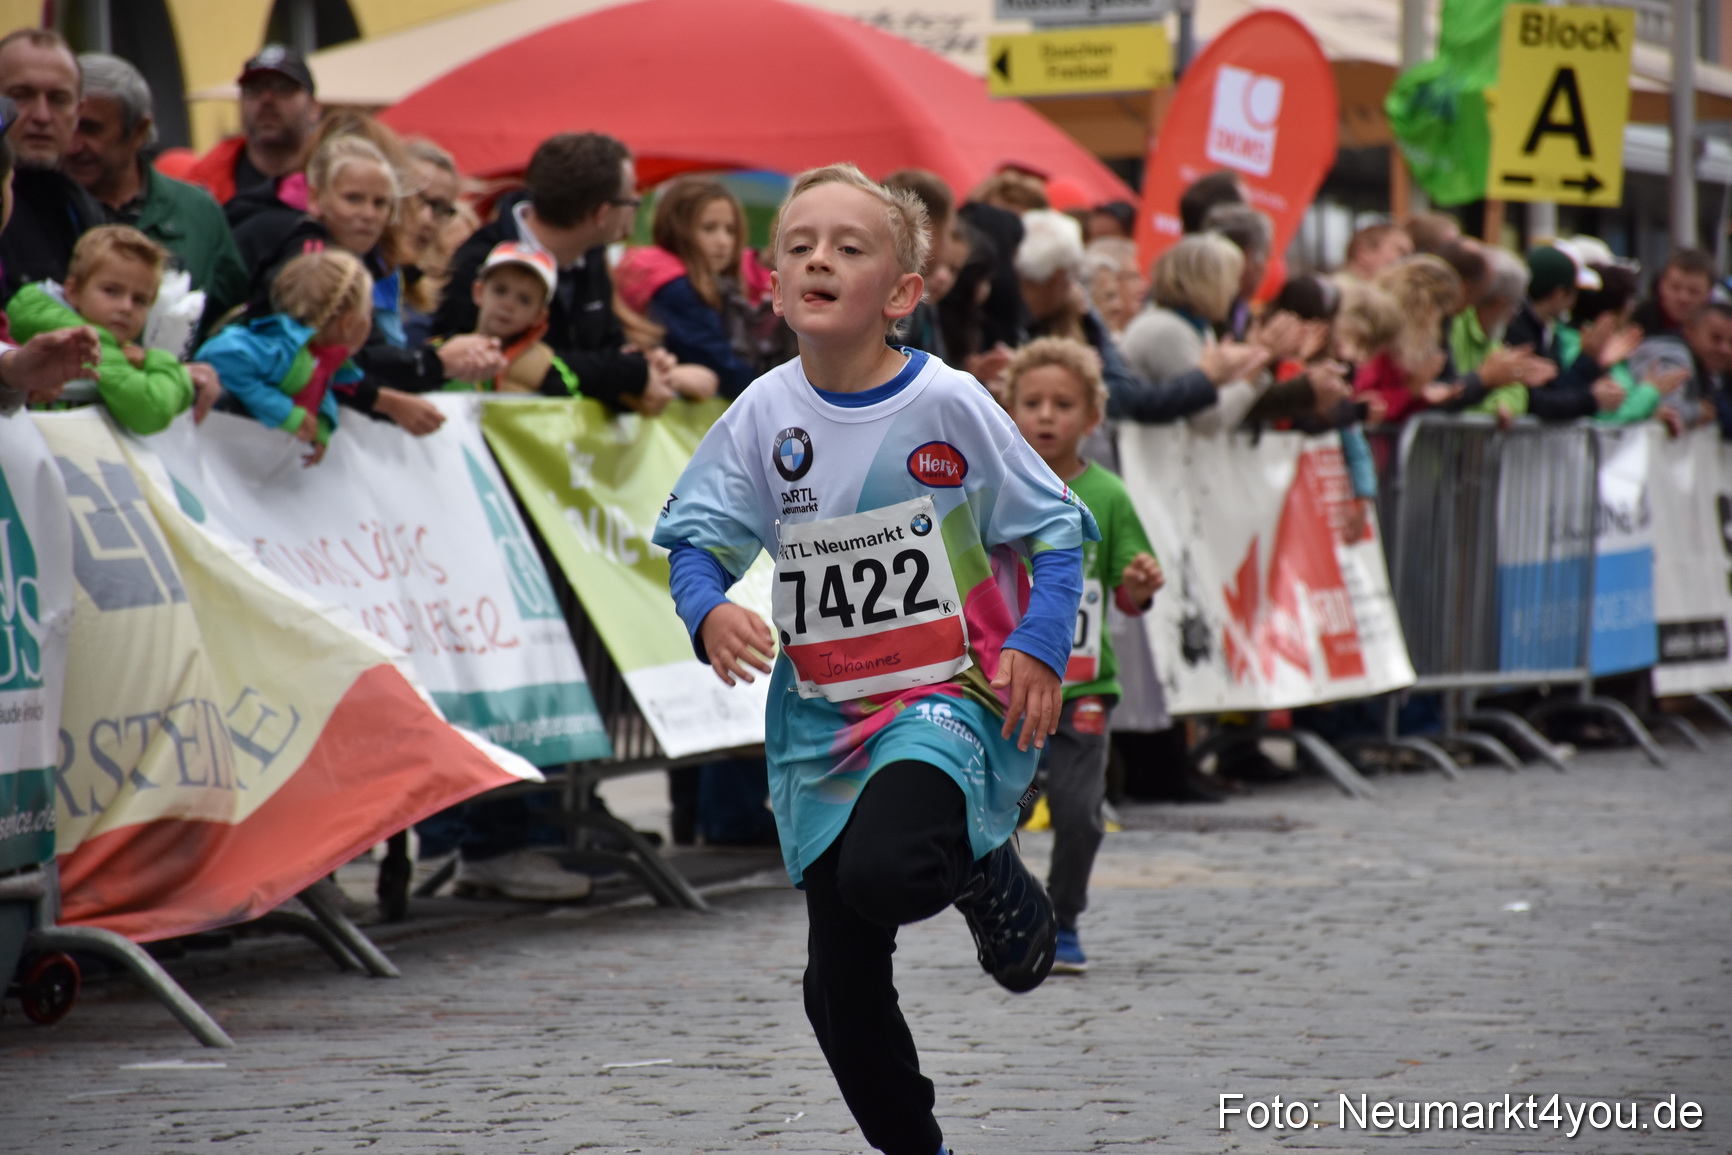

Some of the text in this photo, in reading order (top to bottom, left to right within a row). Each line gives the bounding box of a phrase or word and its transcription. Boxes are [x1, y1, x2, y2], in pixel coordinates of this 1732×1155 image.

[1521, 12, 1622, 51] Block
[1522, 65, 1594, 160] A
[774, 428, 810, 449] BMW
[813, 525, 905, 556] Neumarkt
[779, 548, 940, 635] 7422
[942, 603, 952, 614] K
[819, 651, 902, 678] Johannes
